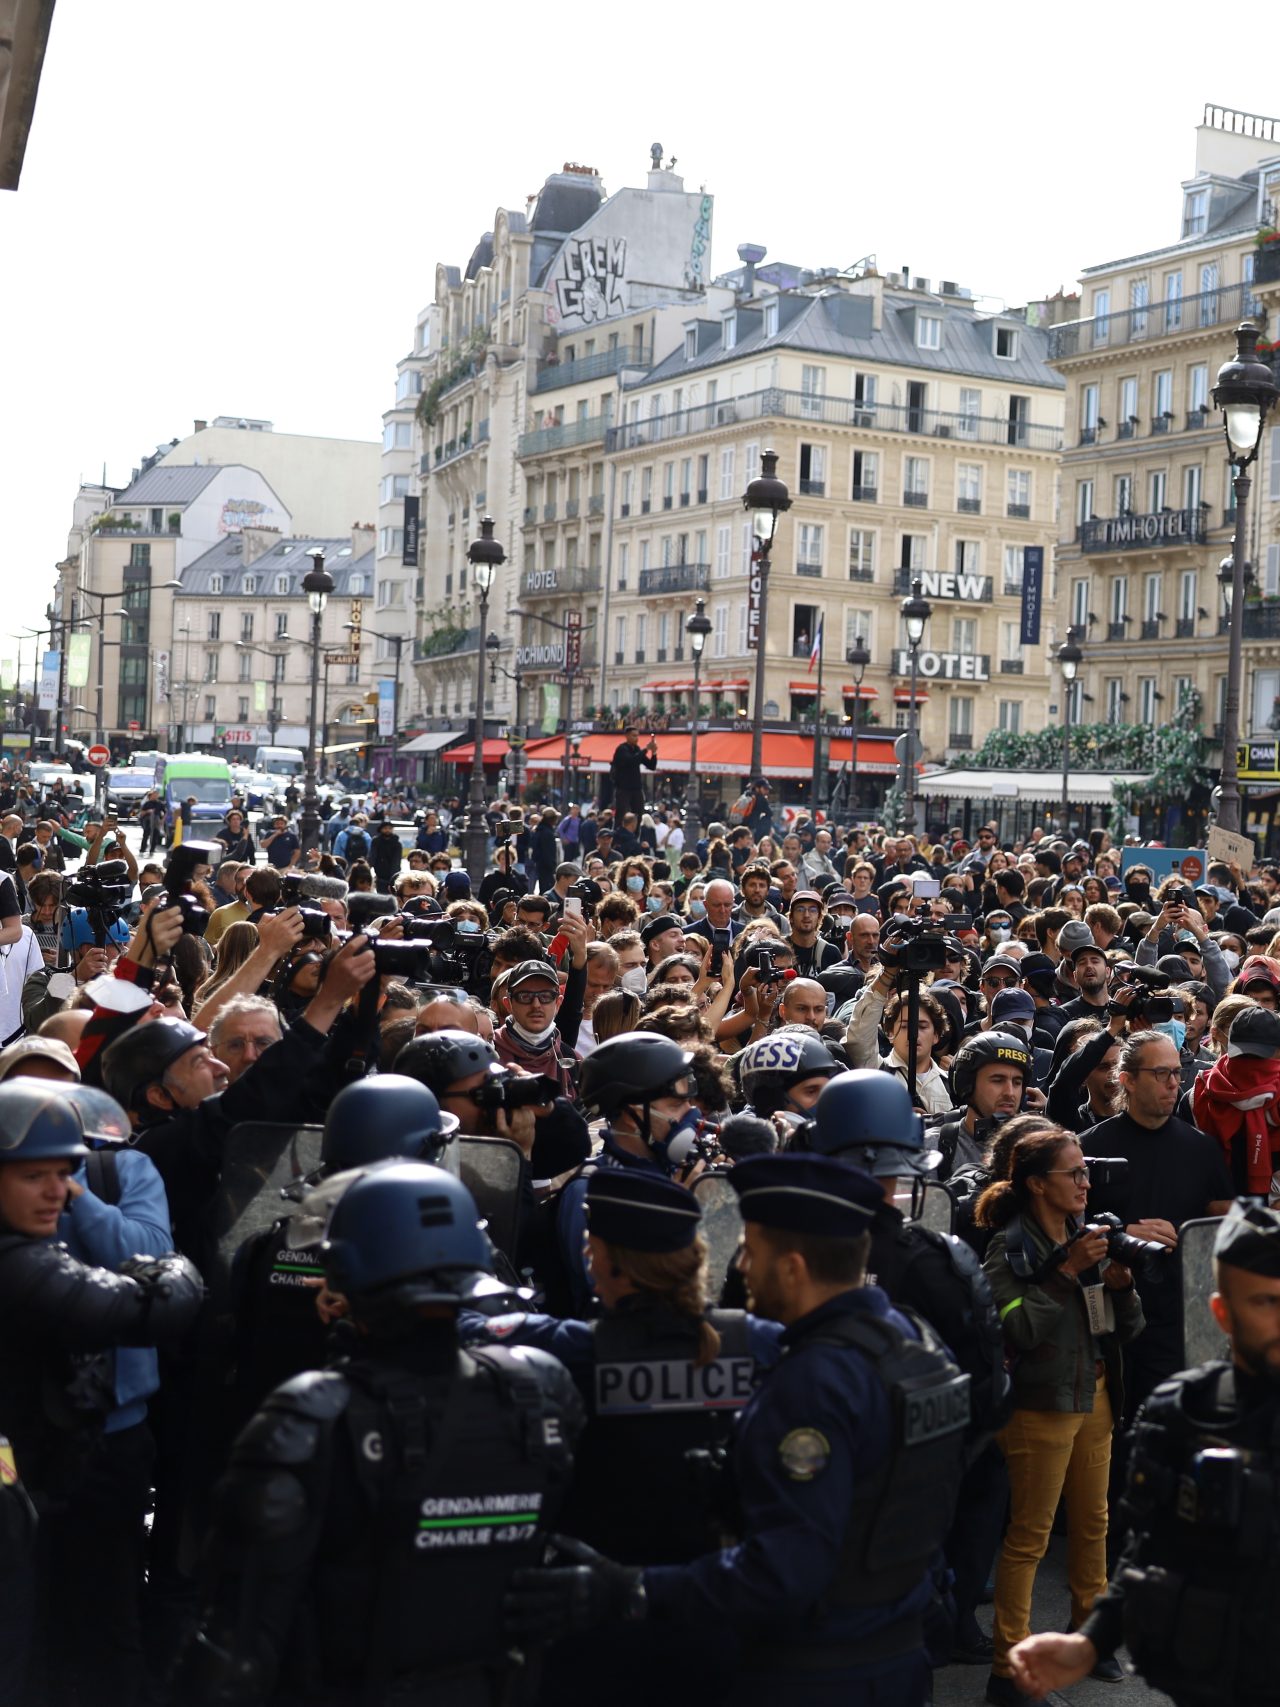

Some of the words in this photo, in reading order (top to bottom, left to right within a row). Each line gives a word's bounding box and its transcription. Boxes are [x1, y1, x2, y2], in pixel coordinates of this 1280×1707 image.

[1102, 514, 1188, 543] TIMHOTEL
[527, 569, 558, 591] HOTEL
[921, 571, 986, 600] NEW
[1026, 567, 1037, 638] TIMHOTEL
[516, 644, 564, 665] RICHMOND
[899, 651, 990, 681] HOTEL
[997, 1048, 1027, 1063] PRESS
[600, 1361, 752, 1401] POLICE
[907, 1382, 970, 1432] POLICE
[421, 1493, 543, 1517] GENDARMERIE
[415, 1527, 492, 1549] CHARLIE
[495, 1524, 537, 1542] 43/7
